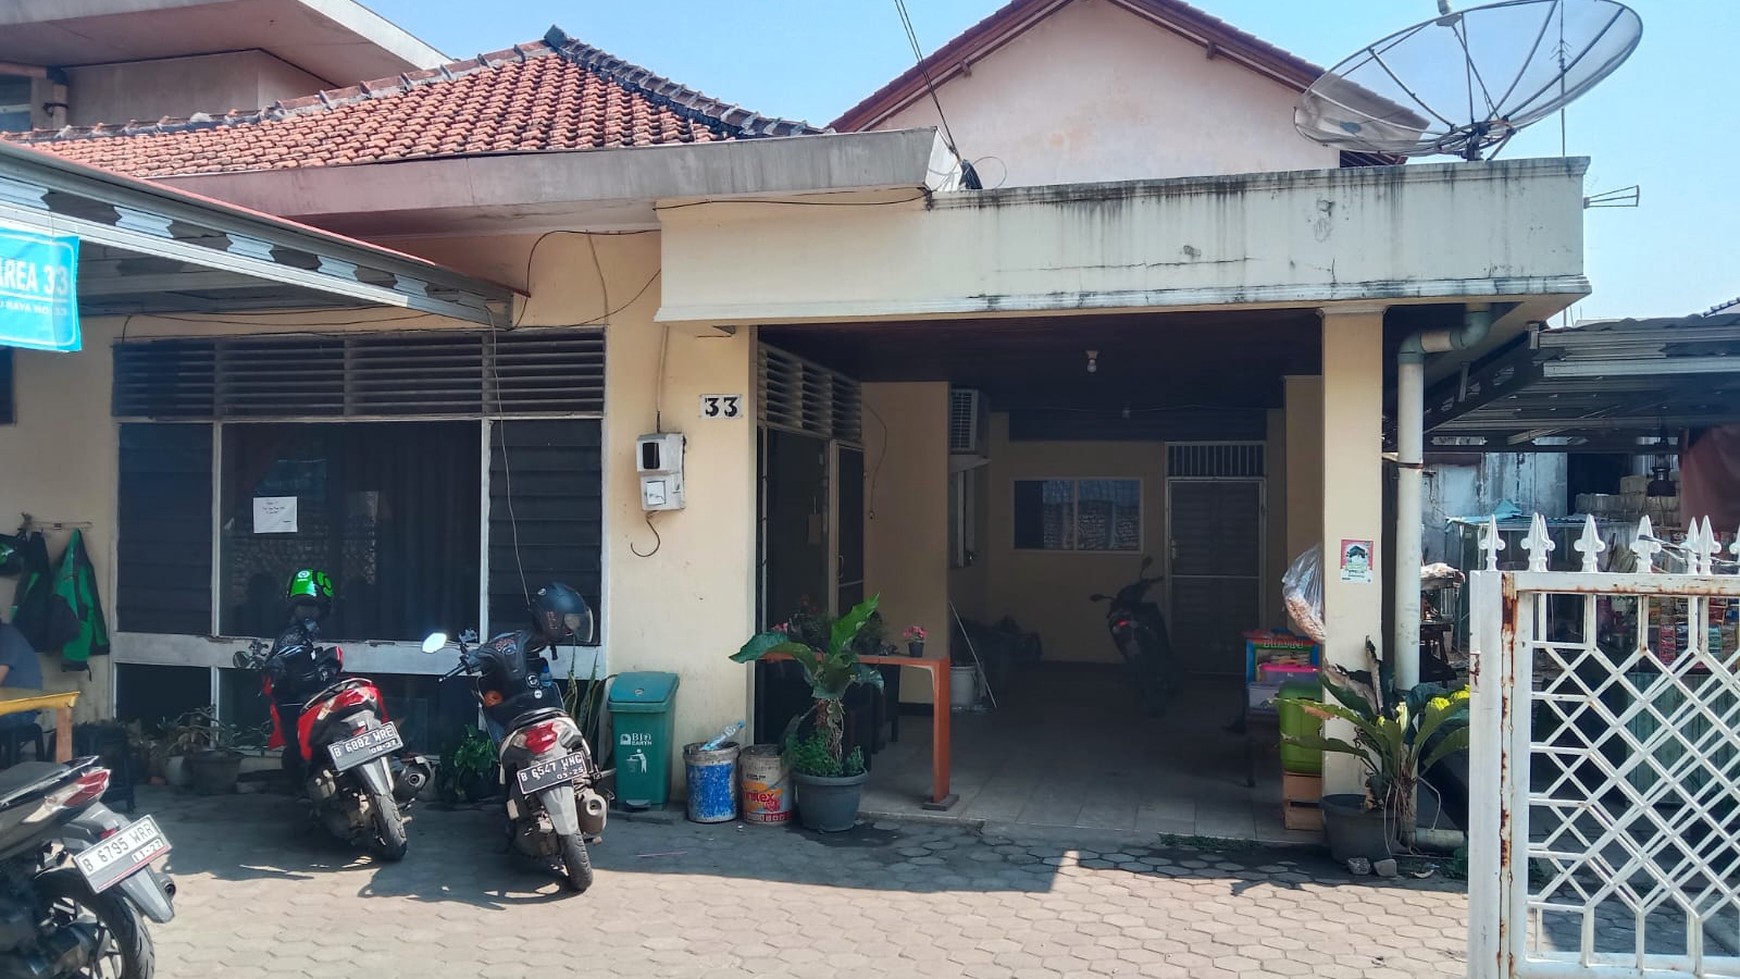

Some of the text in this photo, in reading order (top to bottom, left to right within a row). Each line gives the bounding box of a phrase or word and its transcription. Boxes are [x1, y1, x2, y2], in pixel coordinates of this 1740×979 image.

[43, 264, 68, 296] 33
[705, 397, 738, 418] 33
[333, 746, 342, 758] B
[372, 727, 394, 742] WRE
[520, 771, 528, 782] B
[531, 762, 557, 779] 6547
[82, 822, 156, 873] B 6795 WRR
